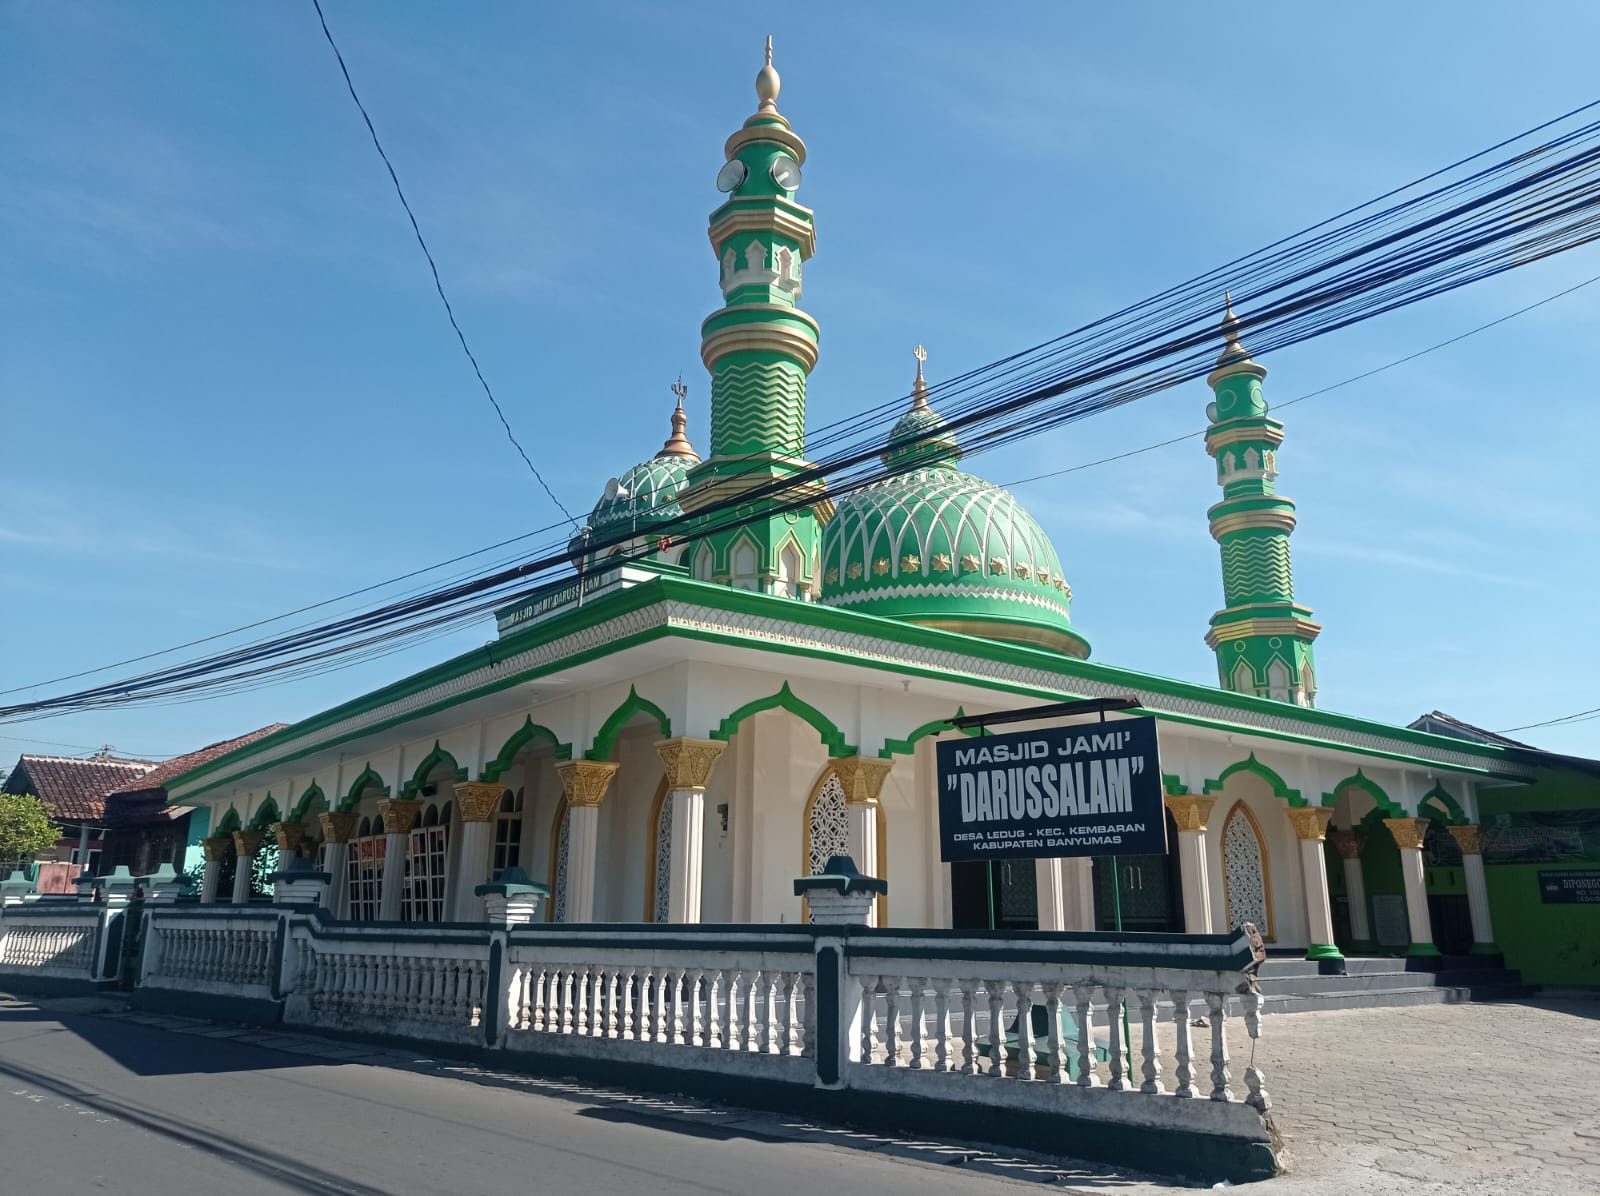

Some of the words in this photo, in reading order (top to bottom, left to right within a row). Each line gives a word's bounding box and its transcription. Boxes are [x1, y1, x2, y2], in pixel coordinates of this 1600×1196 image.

[554, 575, 600, 607] DARUSSLAM
[955, 740, 1049, 767] MASJID
[1058, 731, 1131, 756] JAMI'
[947, 756, 1144, 823] "DARUSSALAM"
[953, 832, 984, 841] DESA
[986, 830, 1025, 840] LEDUG
[1036, 828, 1065, 837] KEC.
[1069, 823, 1145, 835] KEMBARAN
[973, 839, 1043, 850] KABUPATEN
[1046, 835, 1122, 847] BANYUMAS
